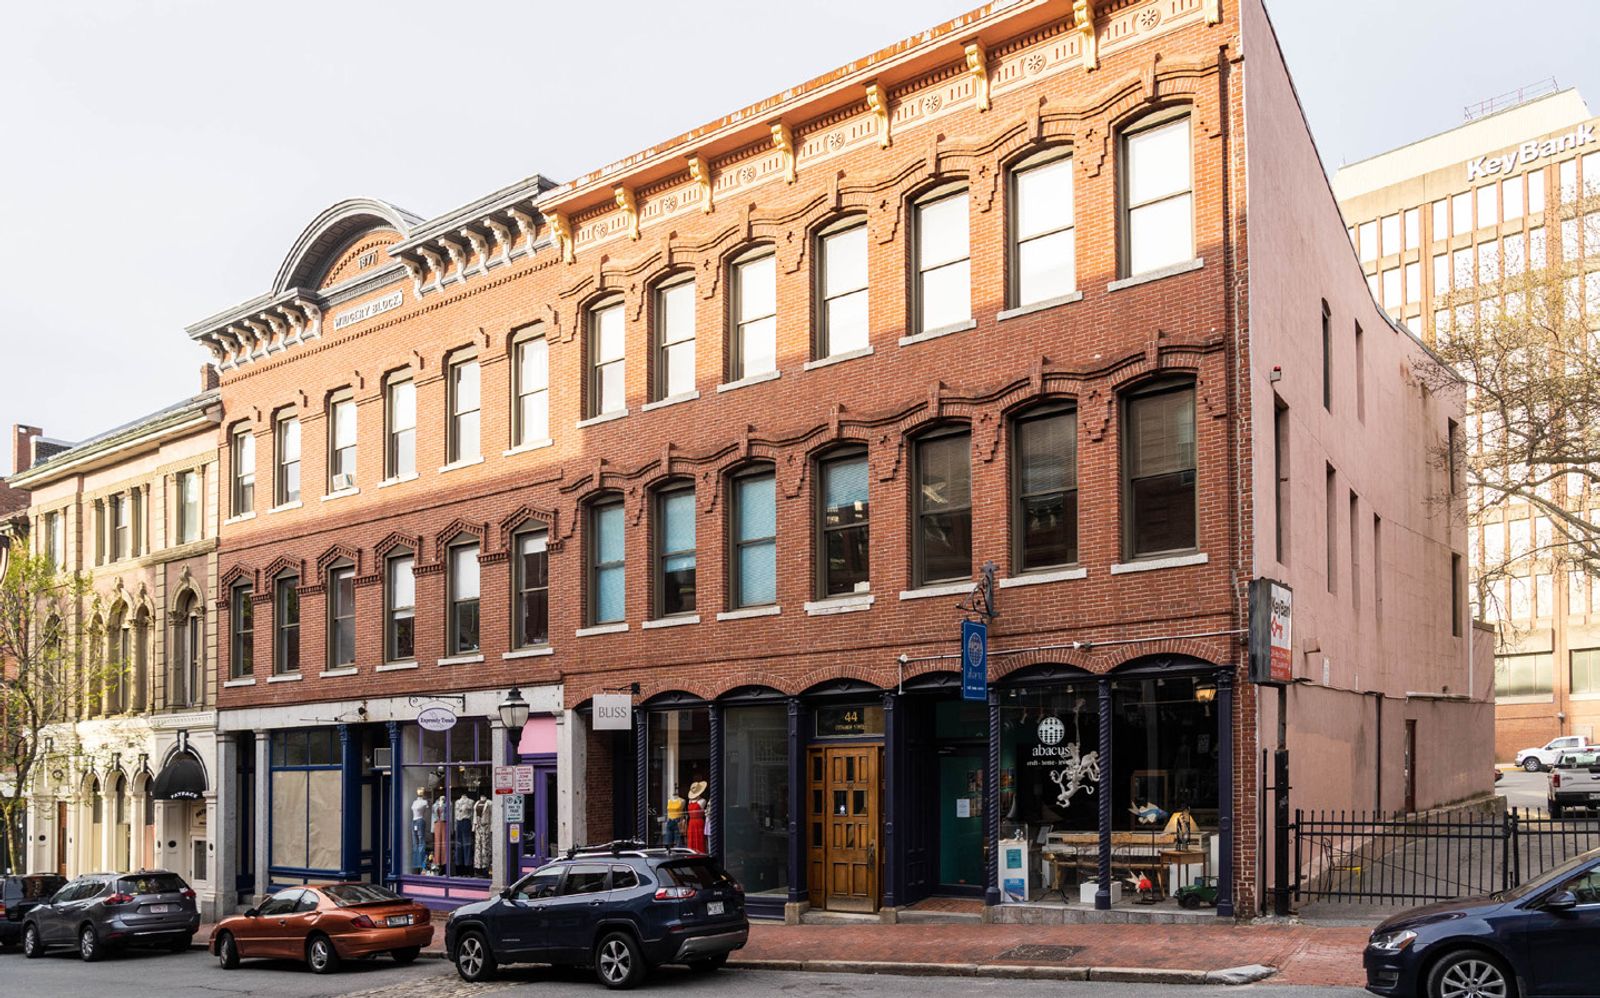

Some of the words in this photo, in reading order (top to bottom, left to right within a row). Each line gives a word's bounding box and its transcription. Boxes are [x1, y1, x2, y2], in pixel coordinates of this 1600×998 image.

[1467, 124, 1596, 182] KeyBank
[598, 706, 627, 718] BLISS
[844, 711, 858, 722] 44
[1032, 744, 1071, 757] abacus
